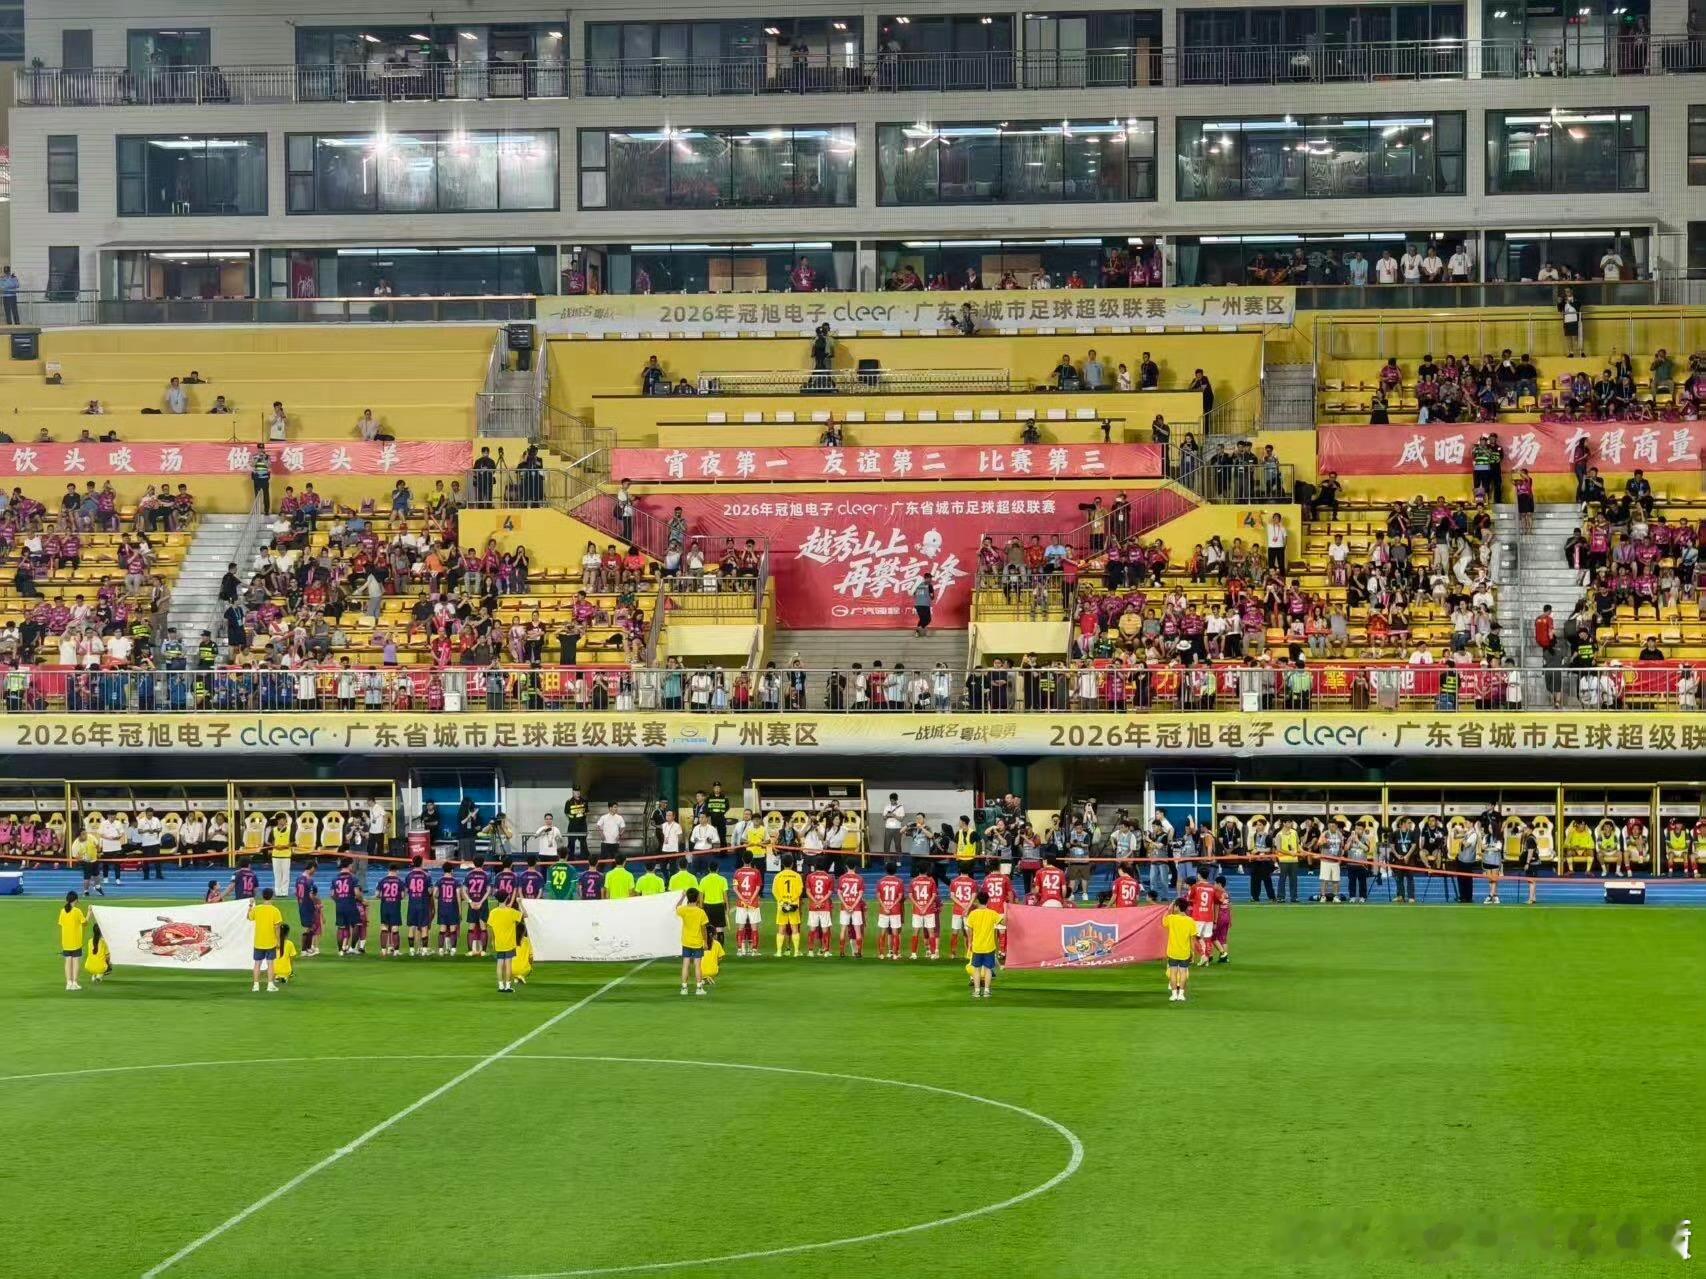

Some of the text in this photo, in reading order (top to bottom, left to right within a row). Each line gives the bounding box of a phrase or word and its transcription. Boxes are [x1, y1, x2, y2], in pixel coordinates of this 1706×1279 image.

[659, 302, 826, 323] 2026年冠旭电子
[833, 299, 893, 322] cleer
[1201, 296, 1285, 316] 广州赛区
[1394, 432, 1541, 469] 威晒场
[12, 446, 184, 473] 饮头啖汤
[664, 447, 1105, 479] 宵夜第一 友谊第二 比赛第三
[723, 502, 833, 517] 2026年冠旭电子
[838, 500, 877, 515] cleer
[503, 515, 514, 531] 4
[1244, 512, 1256, 528] 4
[794, 524, 909, 566] 越秀山上
[833, 554, 968, 604] 再攀高峰
[17, 722, 232, 747] 2026年冠旭电子
[241, 719, 317, 746] cleer
[712, 721, 819, 746] 广州赛区
[1050, 722, 1274, 748] 2026年冠旭电子
[1284, 718, 1368, 746] cleer
[552, 870, 566, 885] 29
[741, 876, 750, 890] 4
[1042, 875, 1060, 890] 42
[336, 879, 349, 893] 36
[442, 884, 453, 899] 10
[469, 879, 485, 893] 27
[527, 880, 533, 894] 6
[587, 879, 594, 893] 2
[784, 880, 791, 893] 1
[815, 880, 823, 894] 8
[842, 882, 858, 897] 24
[883, 885, 895, 900] 11
[914, 885, 928, 900] 14
[955, 886, 971, 900] 43
[987, 882, 1003, 897] 35
[1121, 885, 1135, 900] 50
[1201, 891, 1209, 906] 9
